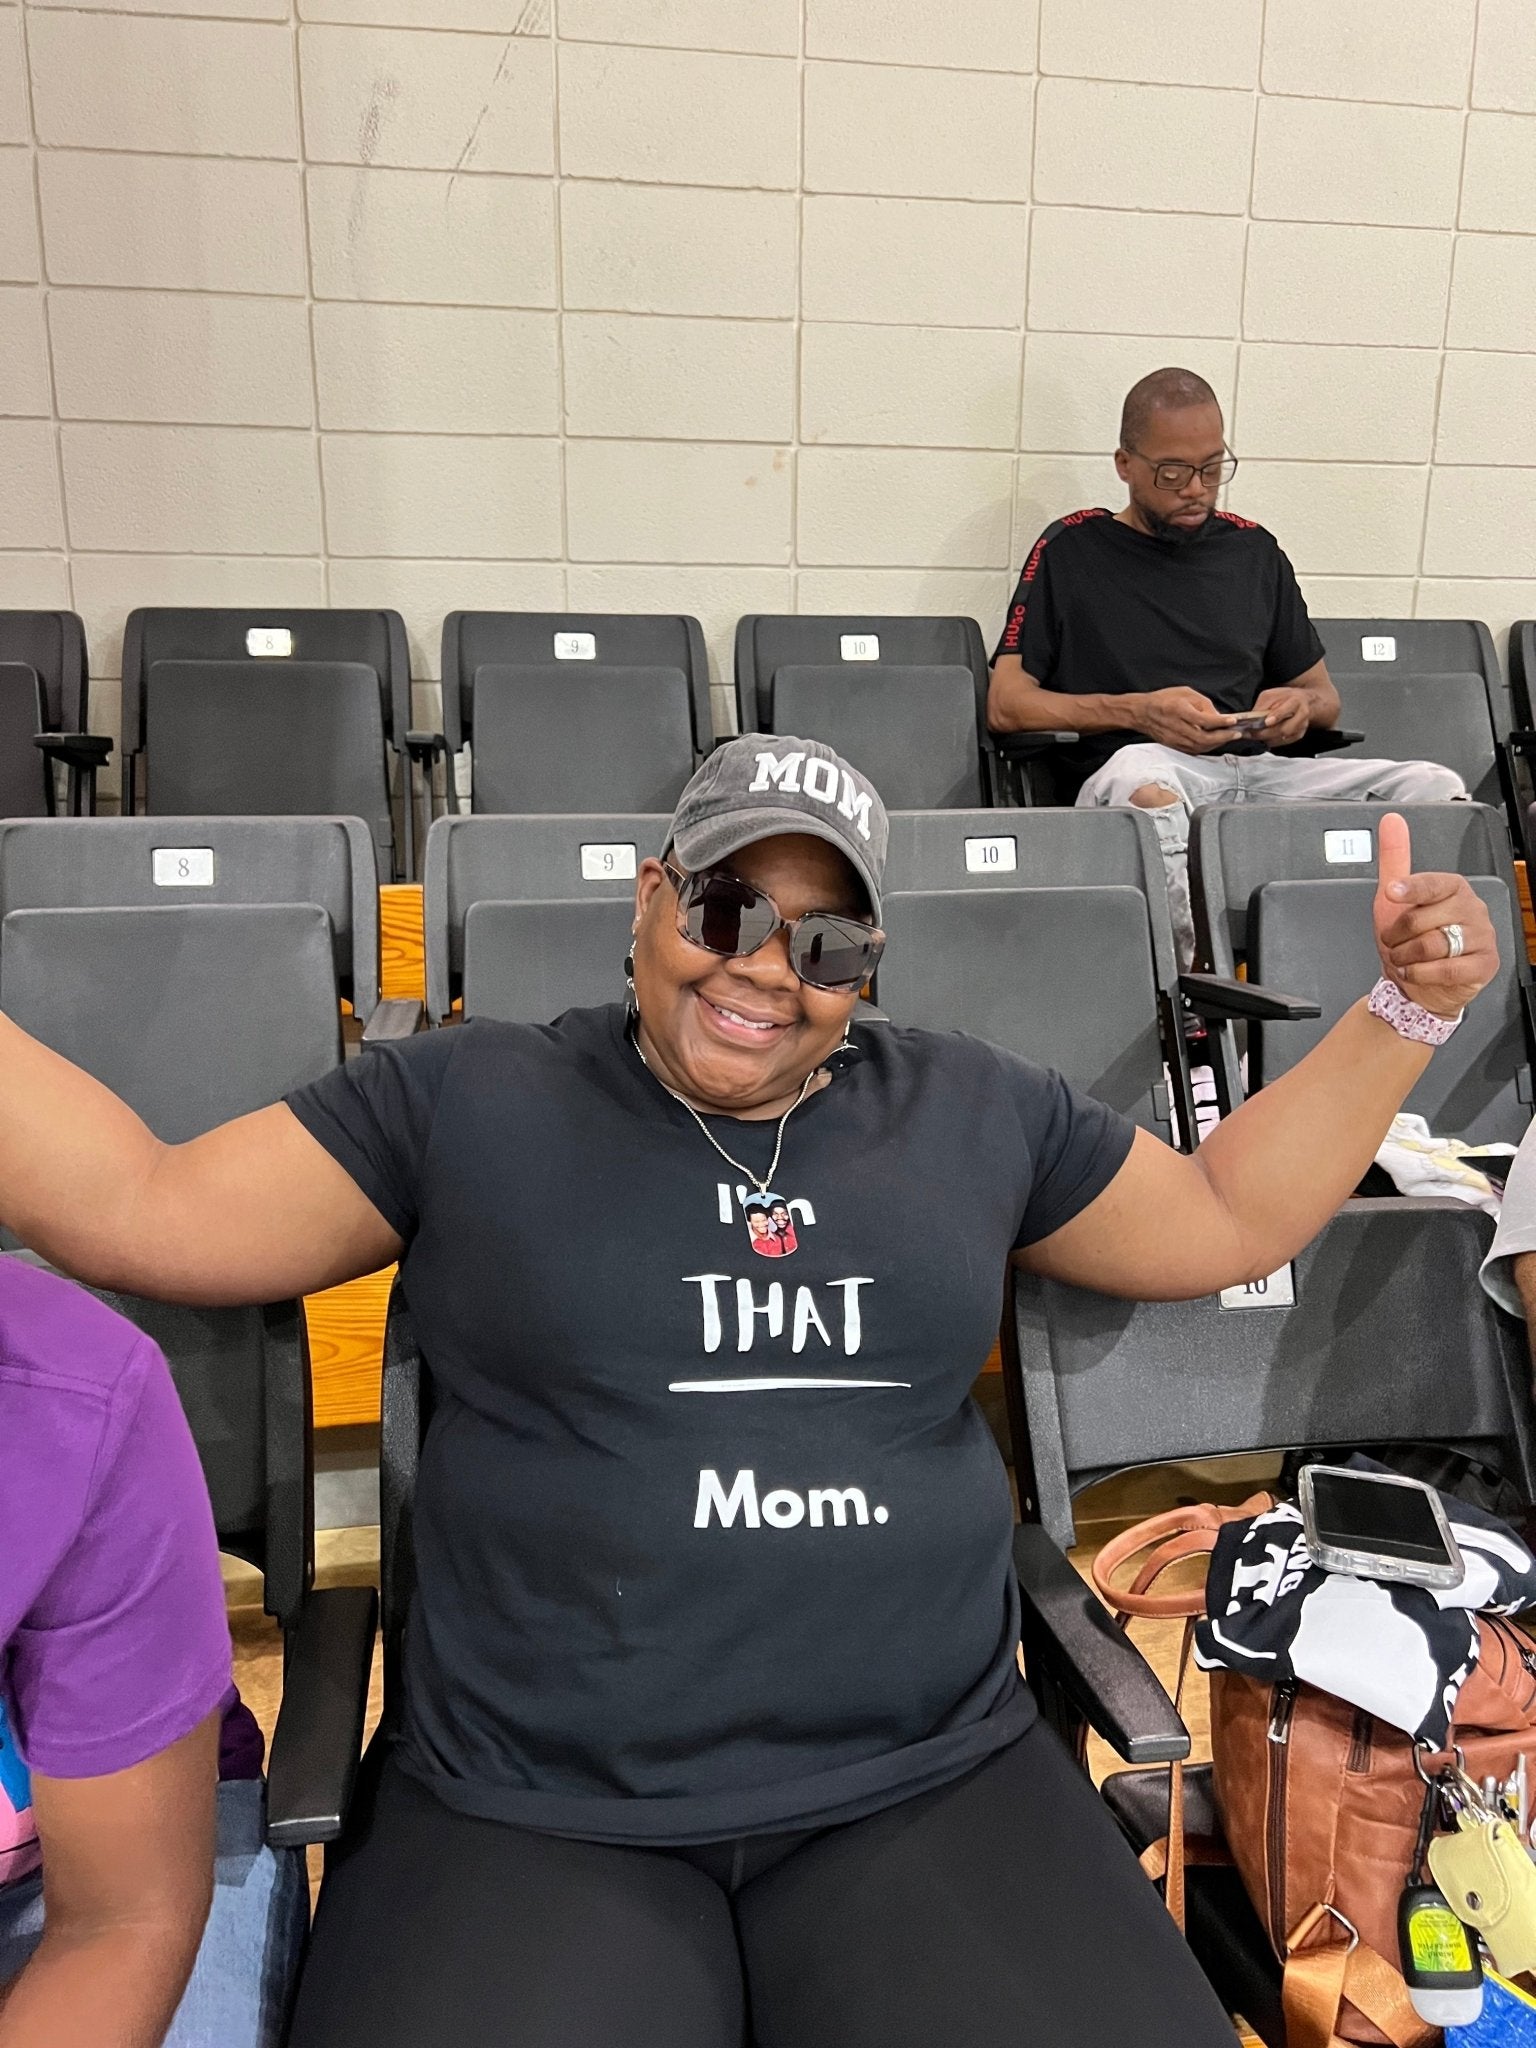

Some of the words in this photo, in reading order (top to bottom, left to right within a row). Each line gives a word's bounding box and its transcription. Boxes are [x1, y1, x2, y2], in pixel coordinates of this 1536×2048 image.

[1062, 510, 1105, 526] HUGO
[1022, 538, 1047, 581] HUGO
[1005, 604, 1026, 647] HUGO
[265, 635, 274, 650] 8
[571, 639, 579, 654] 9
[853, 641, 866, 655] 10
[1372, 643, 1385, 656] 12
[749, 752, 872, 841] MOM
[981, 845, 999, 864] 10
[1342, 838, 1355, 856] 11
[178, 857, 190, 878] 8
[603, 852, 614, 871] 9
[681, 1274, 875, 1356] THAT
[693, 1469, 889, 1529] Mom.
